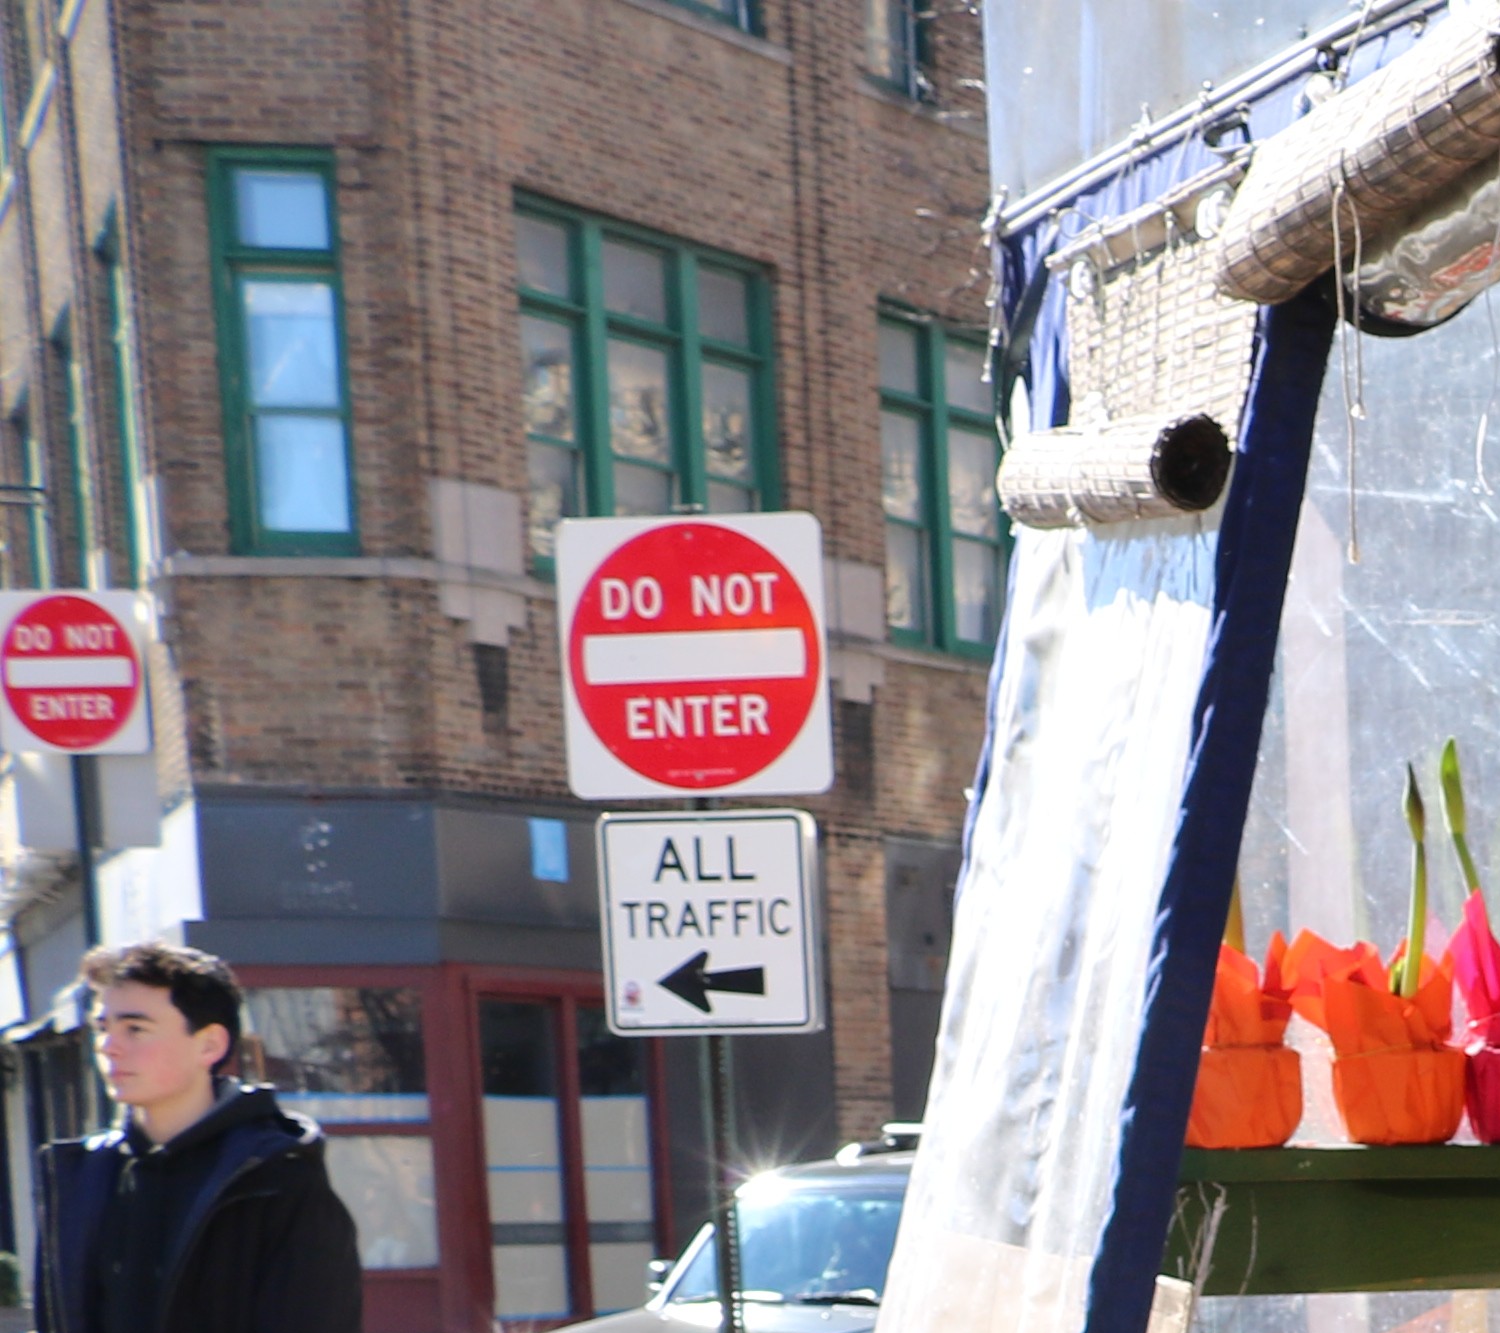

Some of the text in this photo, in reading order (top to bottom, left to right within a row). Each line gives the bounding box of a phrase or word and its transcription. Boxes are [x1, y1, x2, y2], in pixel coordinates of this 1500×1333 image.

[600, 572, 779, 620] DO NOT
[14, 624, 117, 652] DO NOT
[29, 693, 116, 721] ENTER
[625, 693, 770, 739] ENTER
[653, 835, 757, 883] ALL
[620, 898, 793, 939] TRAFFIC
